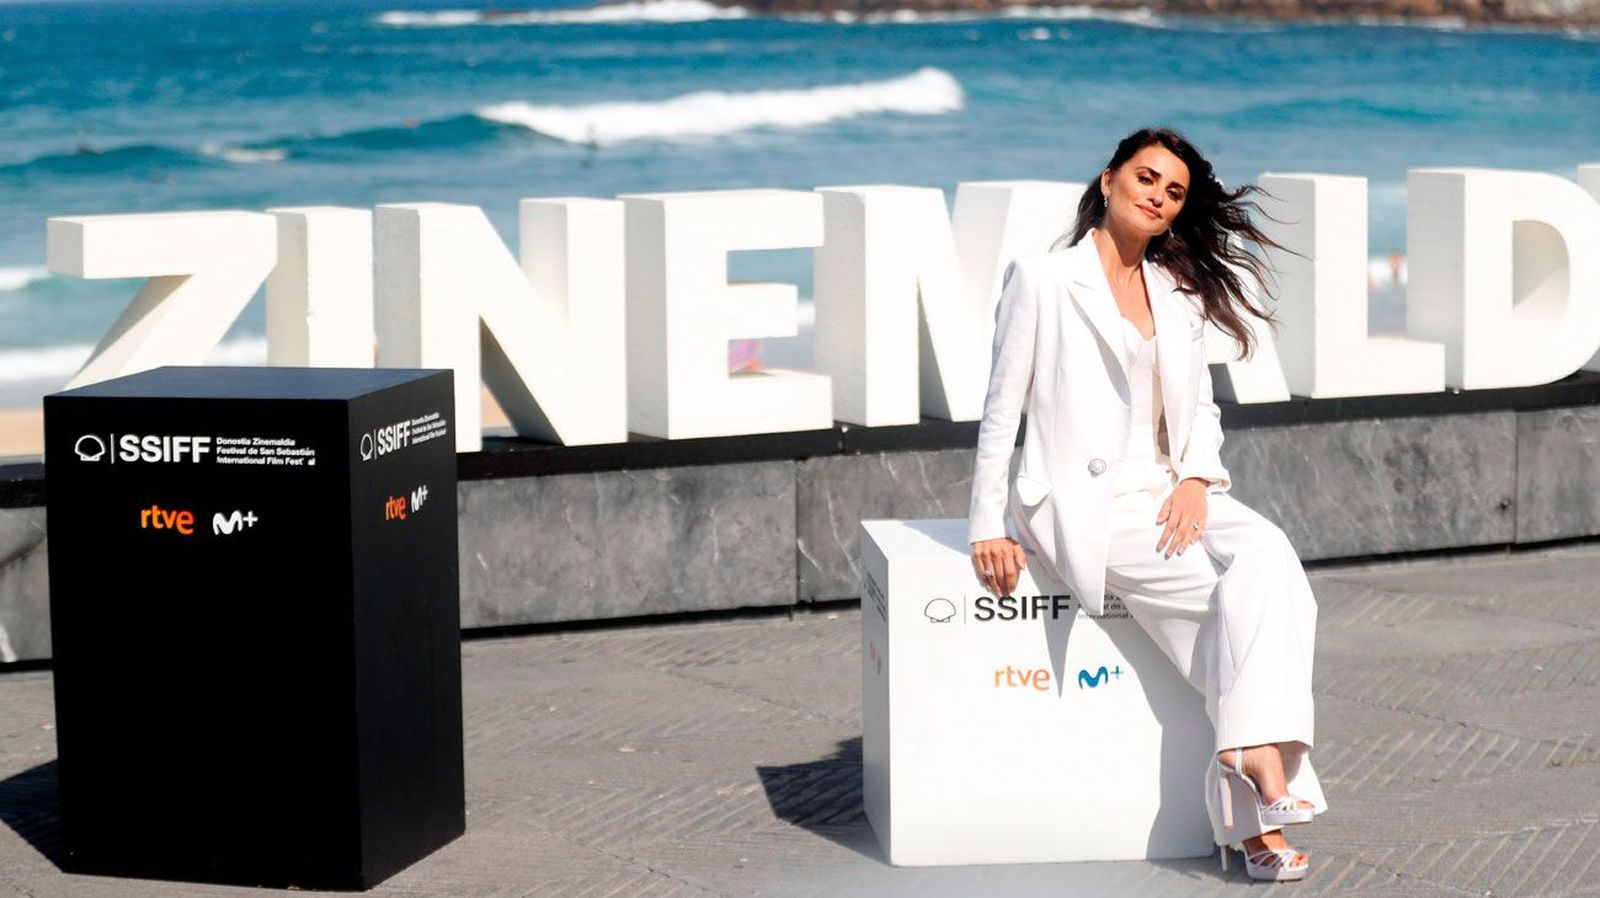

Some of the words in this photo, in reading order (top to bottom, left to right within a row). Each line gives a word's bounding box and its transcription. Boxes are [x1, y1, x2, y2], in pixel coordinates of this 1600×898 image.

[119, 434, 211, 463] SSIFF
[216, 437, 251, 445] Donostia
[252, 437, 295, 446] Zinemaldia
[377, 419, 410, 456] SSIFF
[216, 446, 247, 455] Festival
[247, 447, 258, 455] de
[259, 447, 275, 455] San
[276, 447, 315, 456] Sebastián
[216, 456, 265, 464] International
[266, 456, 284, 465] Film
[141, 505, 194, 535] rtve
[974, 595, 1071, 621] SSIFF
[994, 665, 1050, 691] rtve
